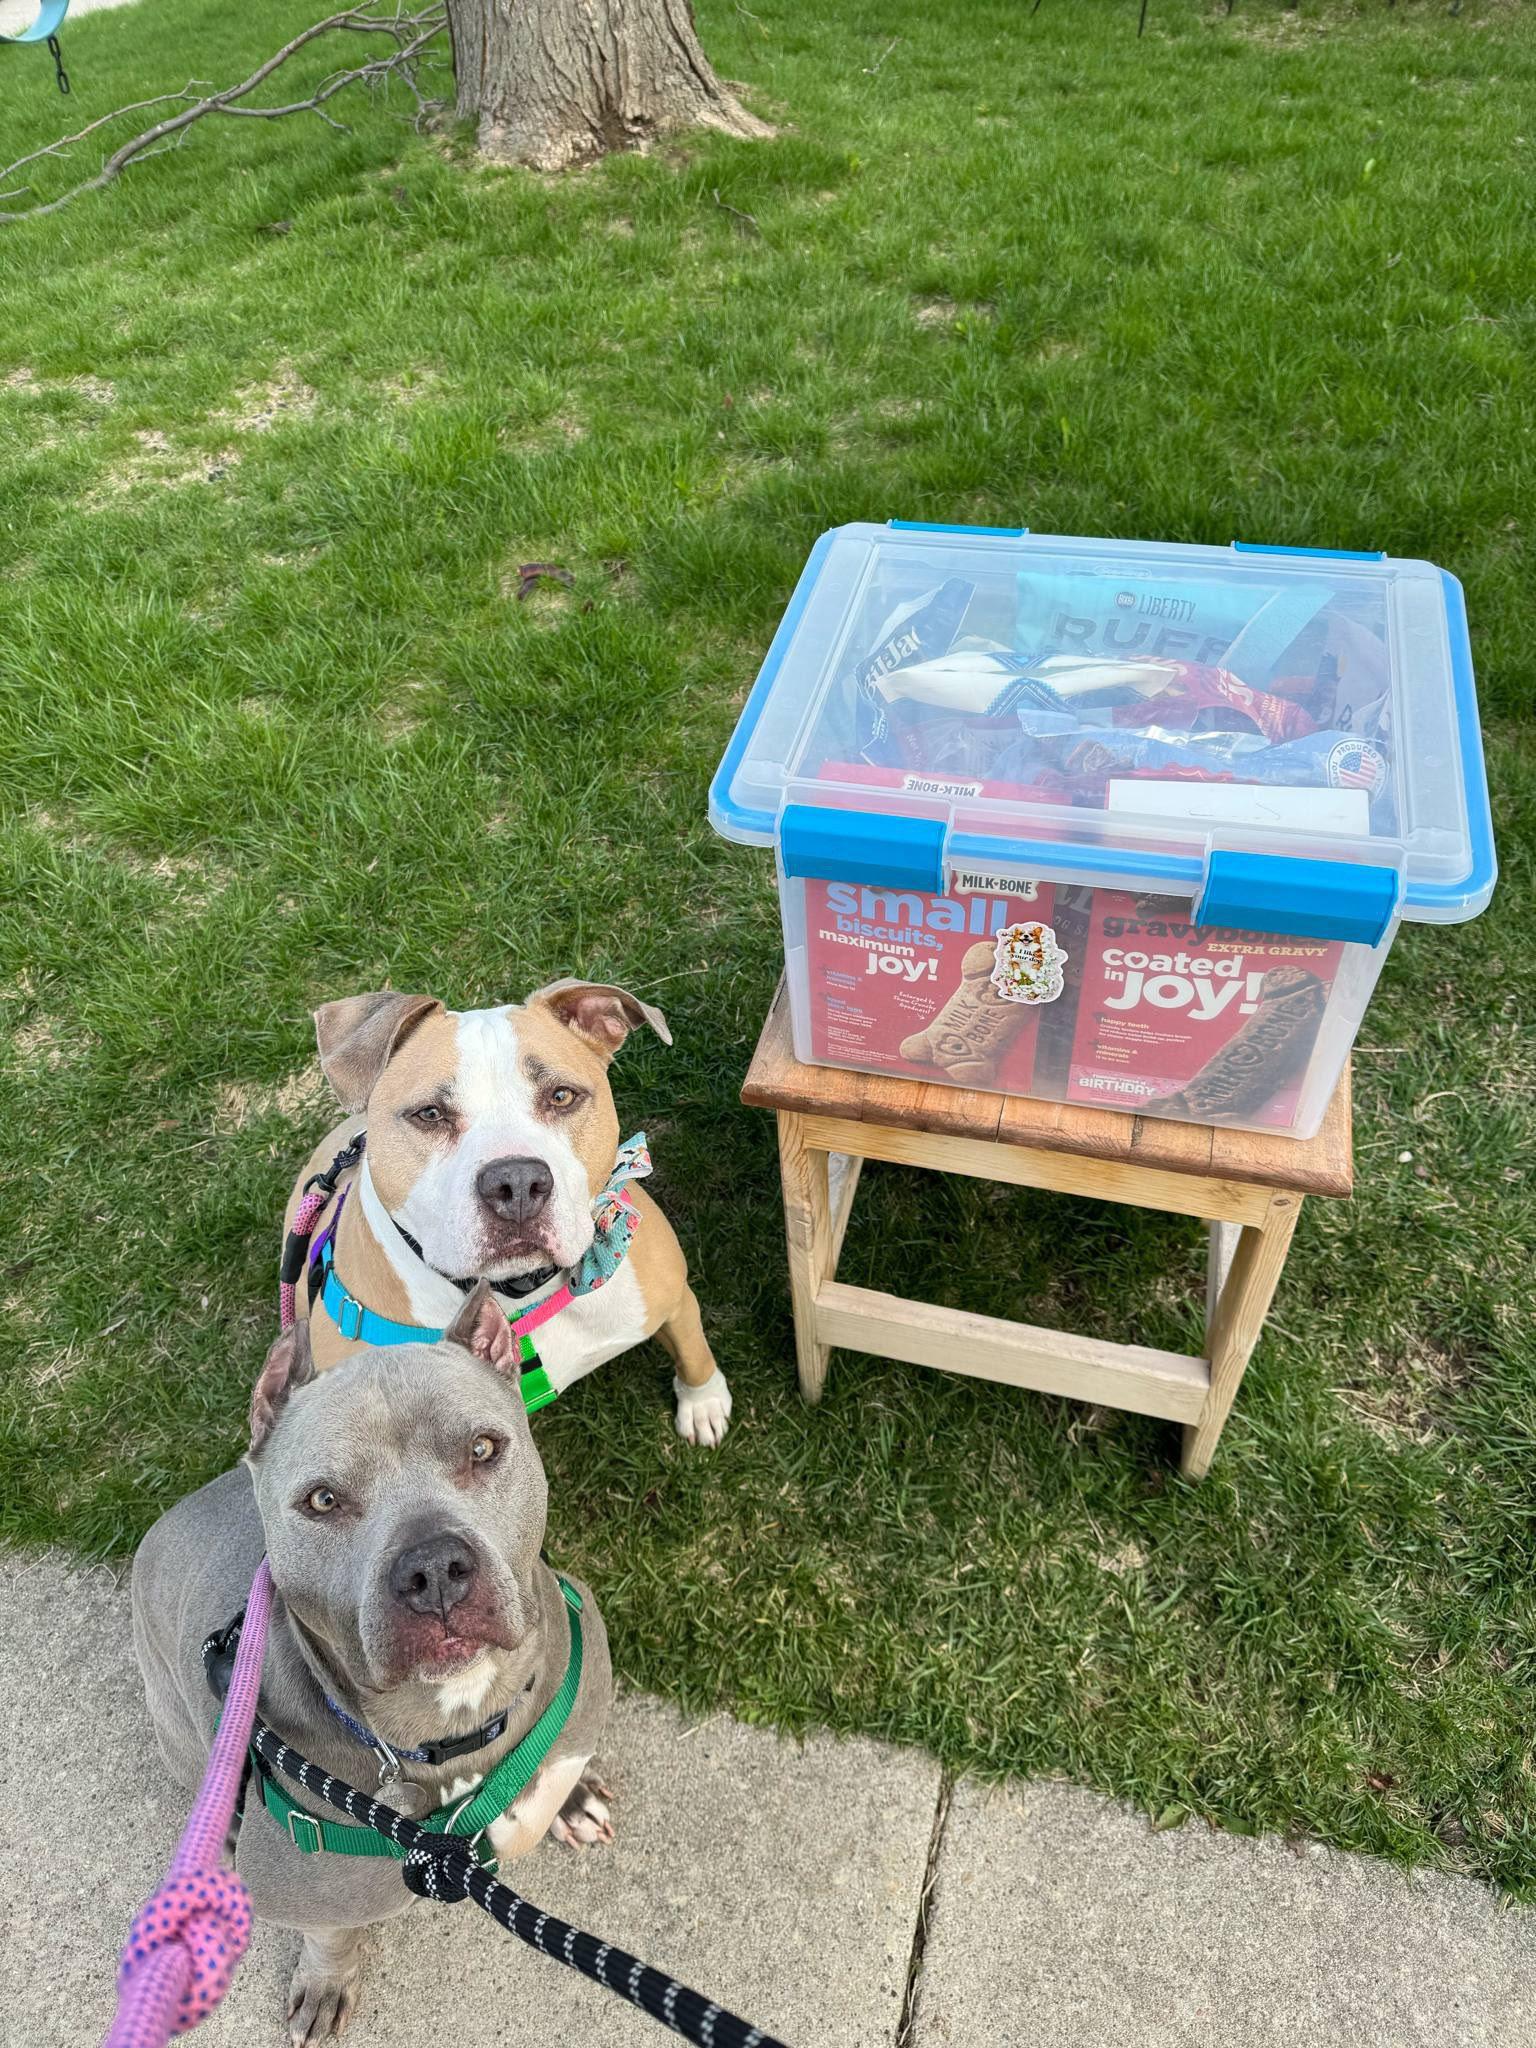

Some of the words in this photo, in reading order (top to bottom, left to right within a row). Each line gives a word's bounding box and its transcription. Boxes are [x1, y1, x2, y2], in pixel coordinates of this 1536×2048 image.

[1336, 744, 1377, 760] PRODUCED
[826, 882, 1008, 937] small
[819, 928, 915, 957] maximum
[837, 915, 943, 951] biscuits,
[1102, 949, 1244, 979] coated
[1206, 943, 1266, 956] EXTRA
[1268, 946, 1329, 957] GRAVY
[865, 952, 939, 983] joy!
[1104, 967, 1124, 982] in
[943, 999, 979, 1032] MILK
[966, 1008, 1009, 1044] BONE
[1079, 1077, 1157, 1096] BIRTHDAY
